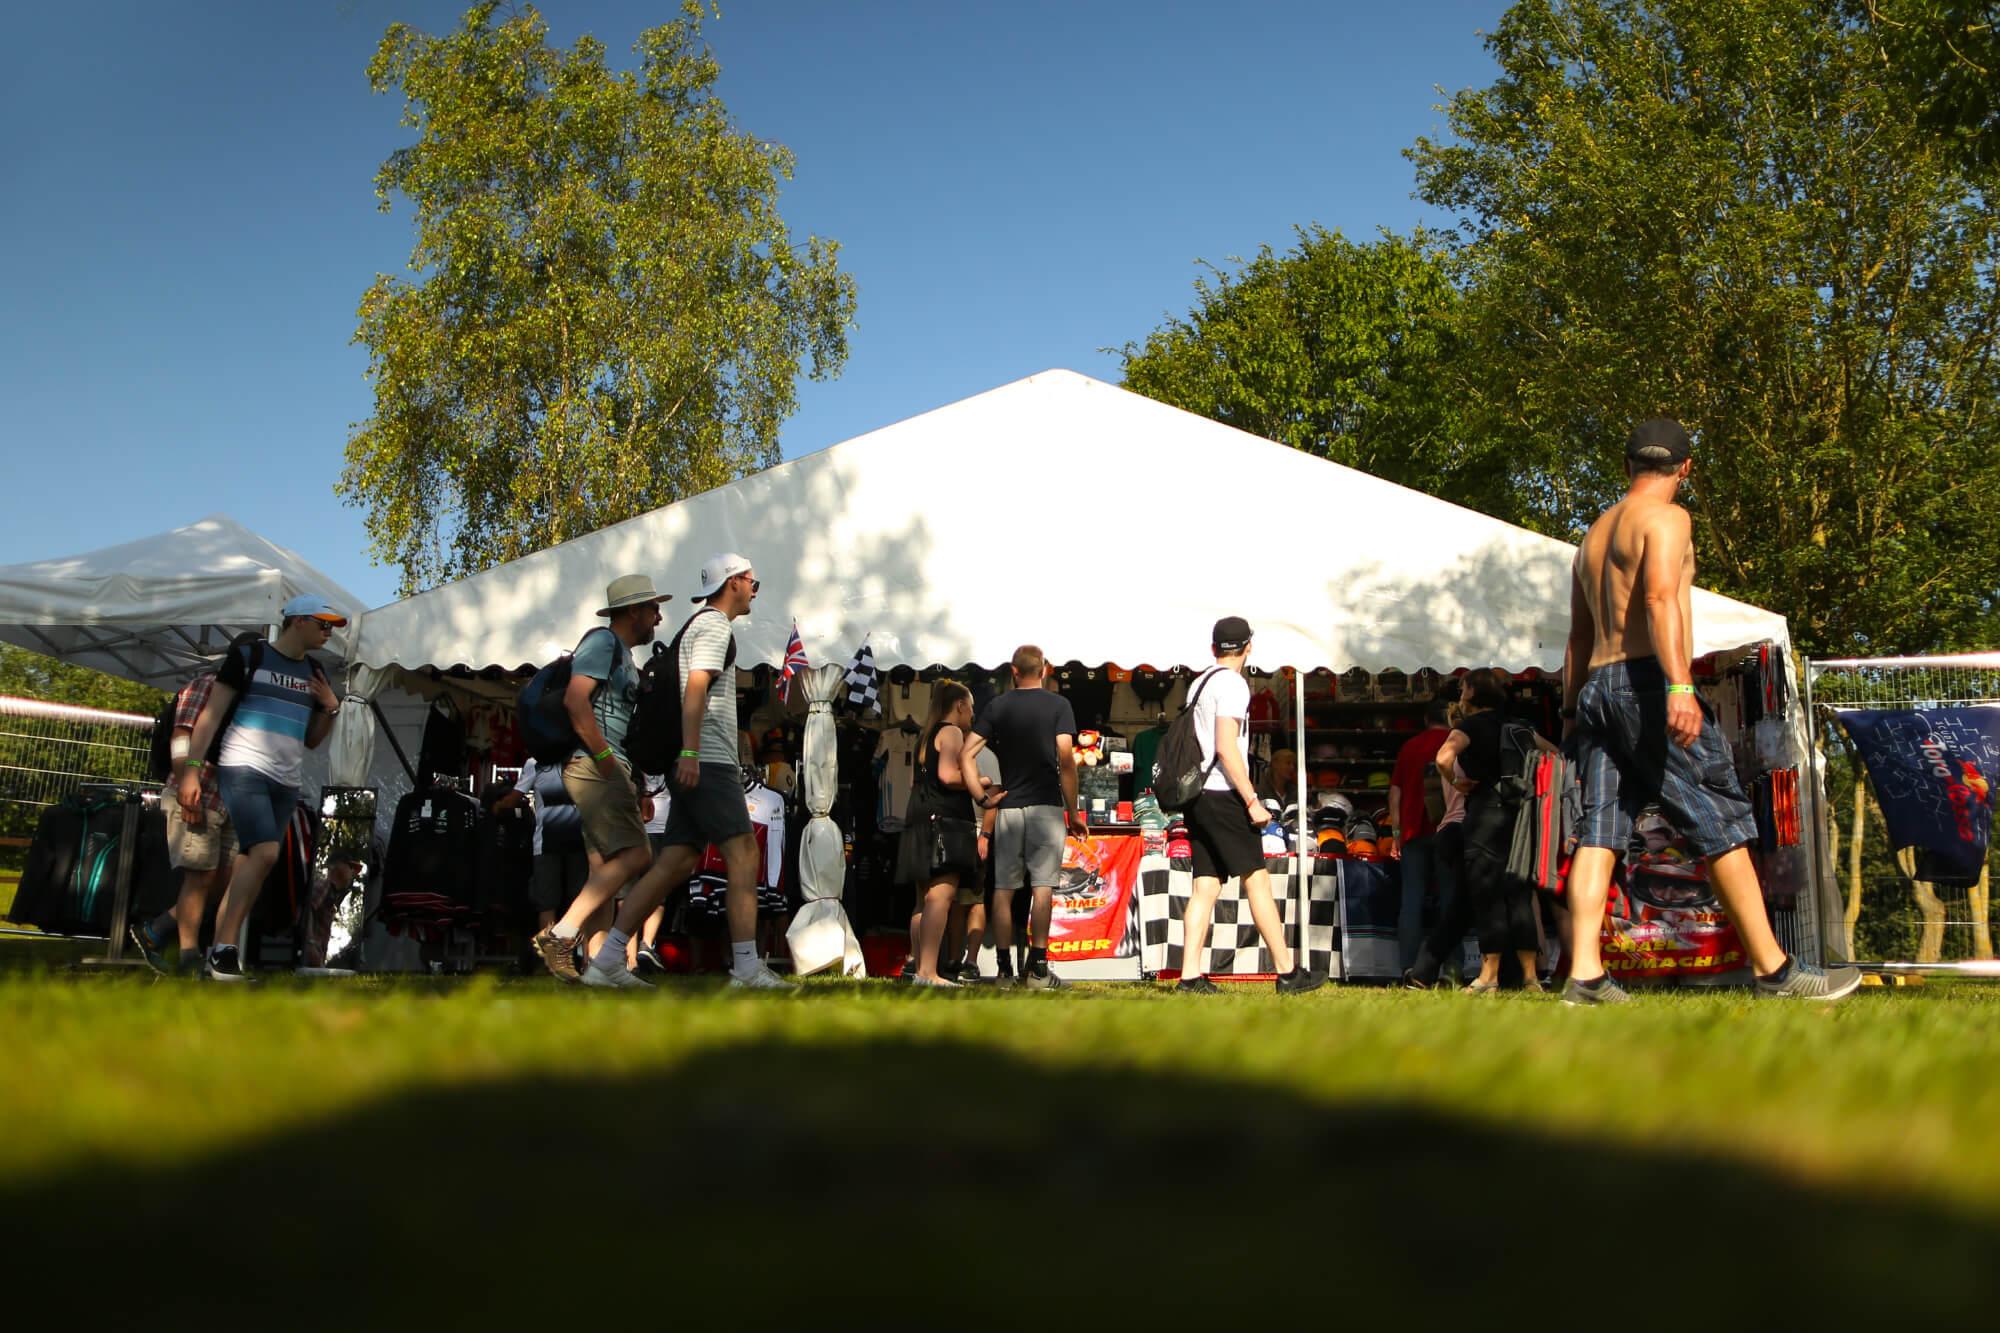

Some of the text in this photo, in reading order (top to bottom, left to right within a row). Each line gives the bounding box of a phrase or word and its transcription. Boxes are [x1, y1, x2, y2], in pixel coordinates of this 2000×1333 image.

[1065, 897, 1106, 909] TIMES
[1602, 938, 1681, 954] CHAEL
[1602, 951, 1740, 971] HUMACHER
